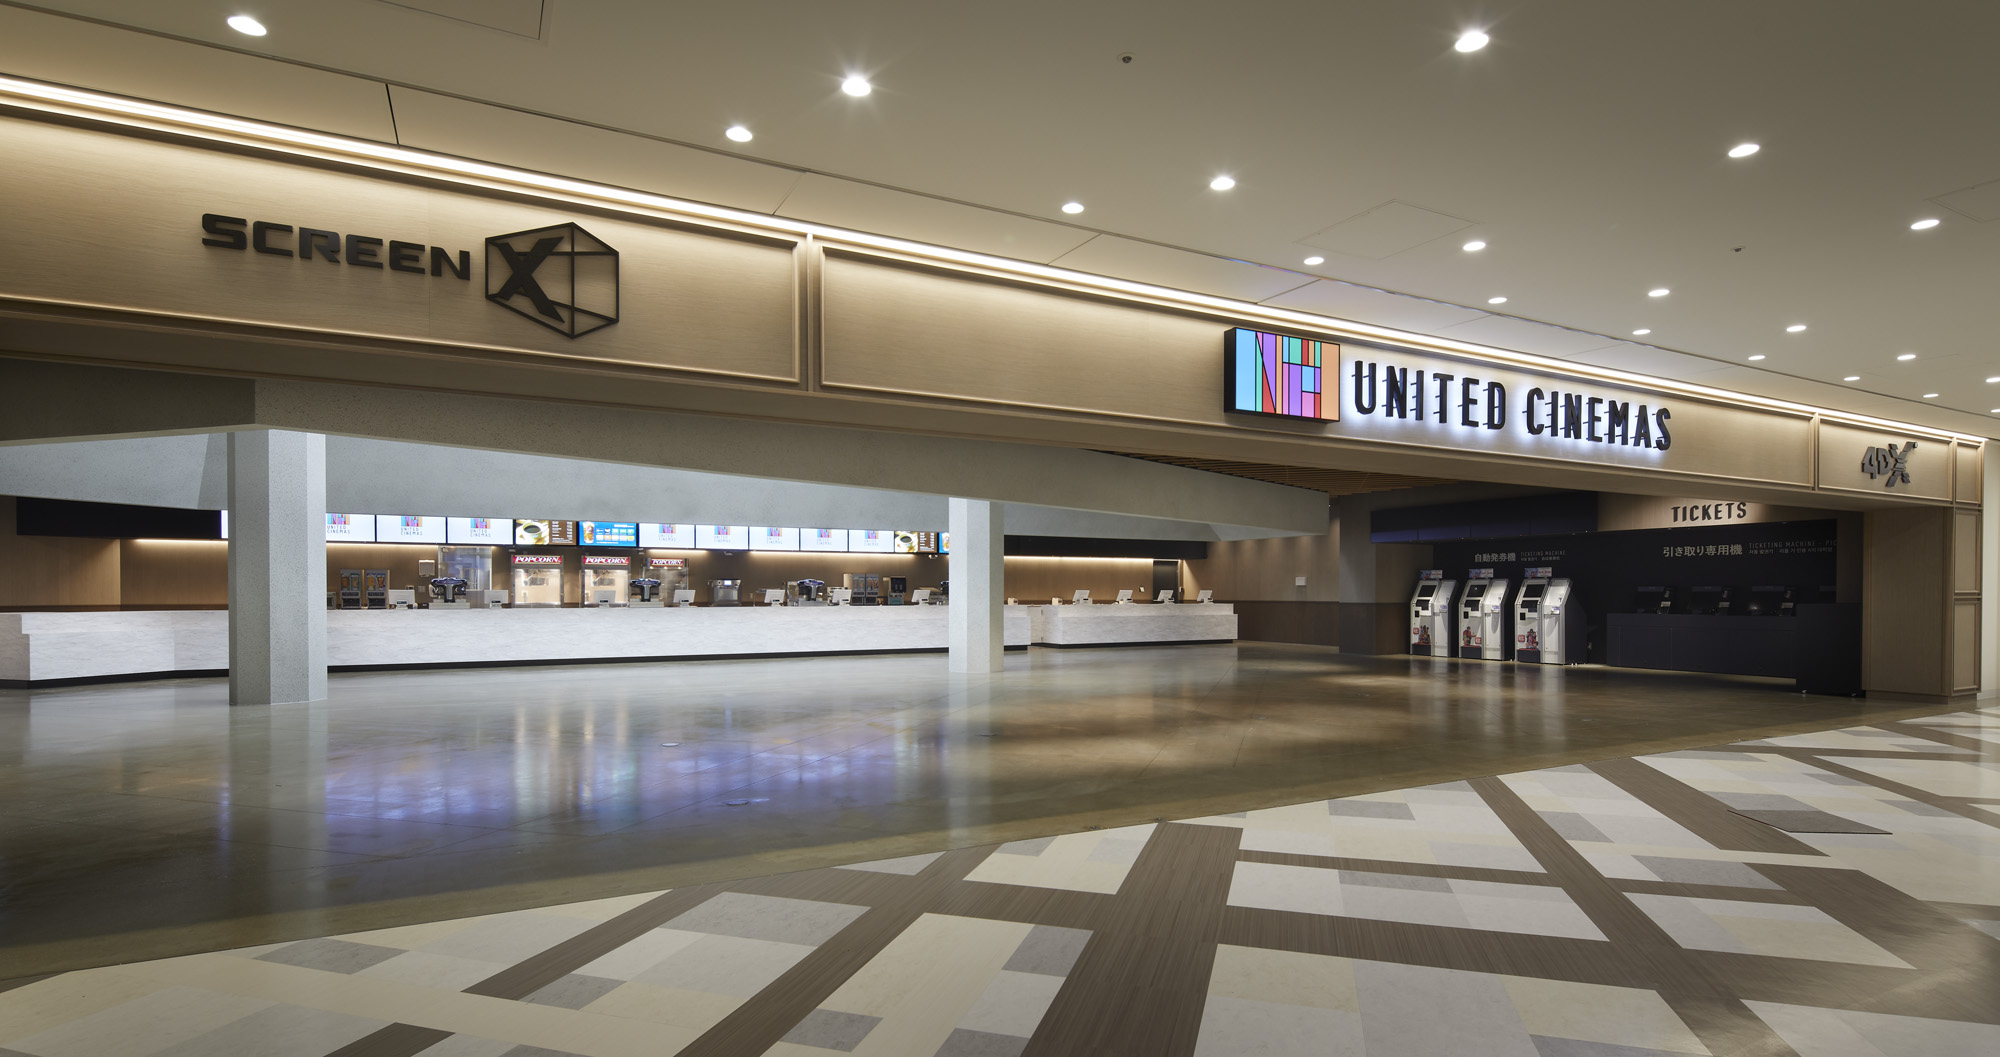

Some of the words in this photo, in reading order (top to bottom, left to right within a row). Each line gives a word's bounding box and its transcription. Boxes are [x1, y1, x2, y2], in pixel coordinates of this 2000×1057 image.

[201, 212, 471, 281] SCREEN
[1352, 359, 1507, 431] UNITED
[1524, 386, 1672, 452] CINEMAS
[1860, 440, 1917, 488] 4DX
[1671, 501, 1747, 523] TICKETS
[1662, 544, 1743, 558] 引き取り専用機
[1748, 541, 1783, 549] TICKETING
[1785, 540, 1816, 548] MACHINE
[515, 555, 559, 563] POPCORN
[1474, 552, 1516, 562] 自動発券機
